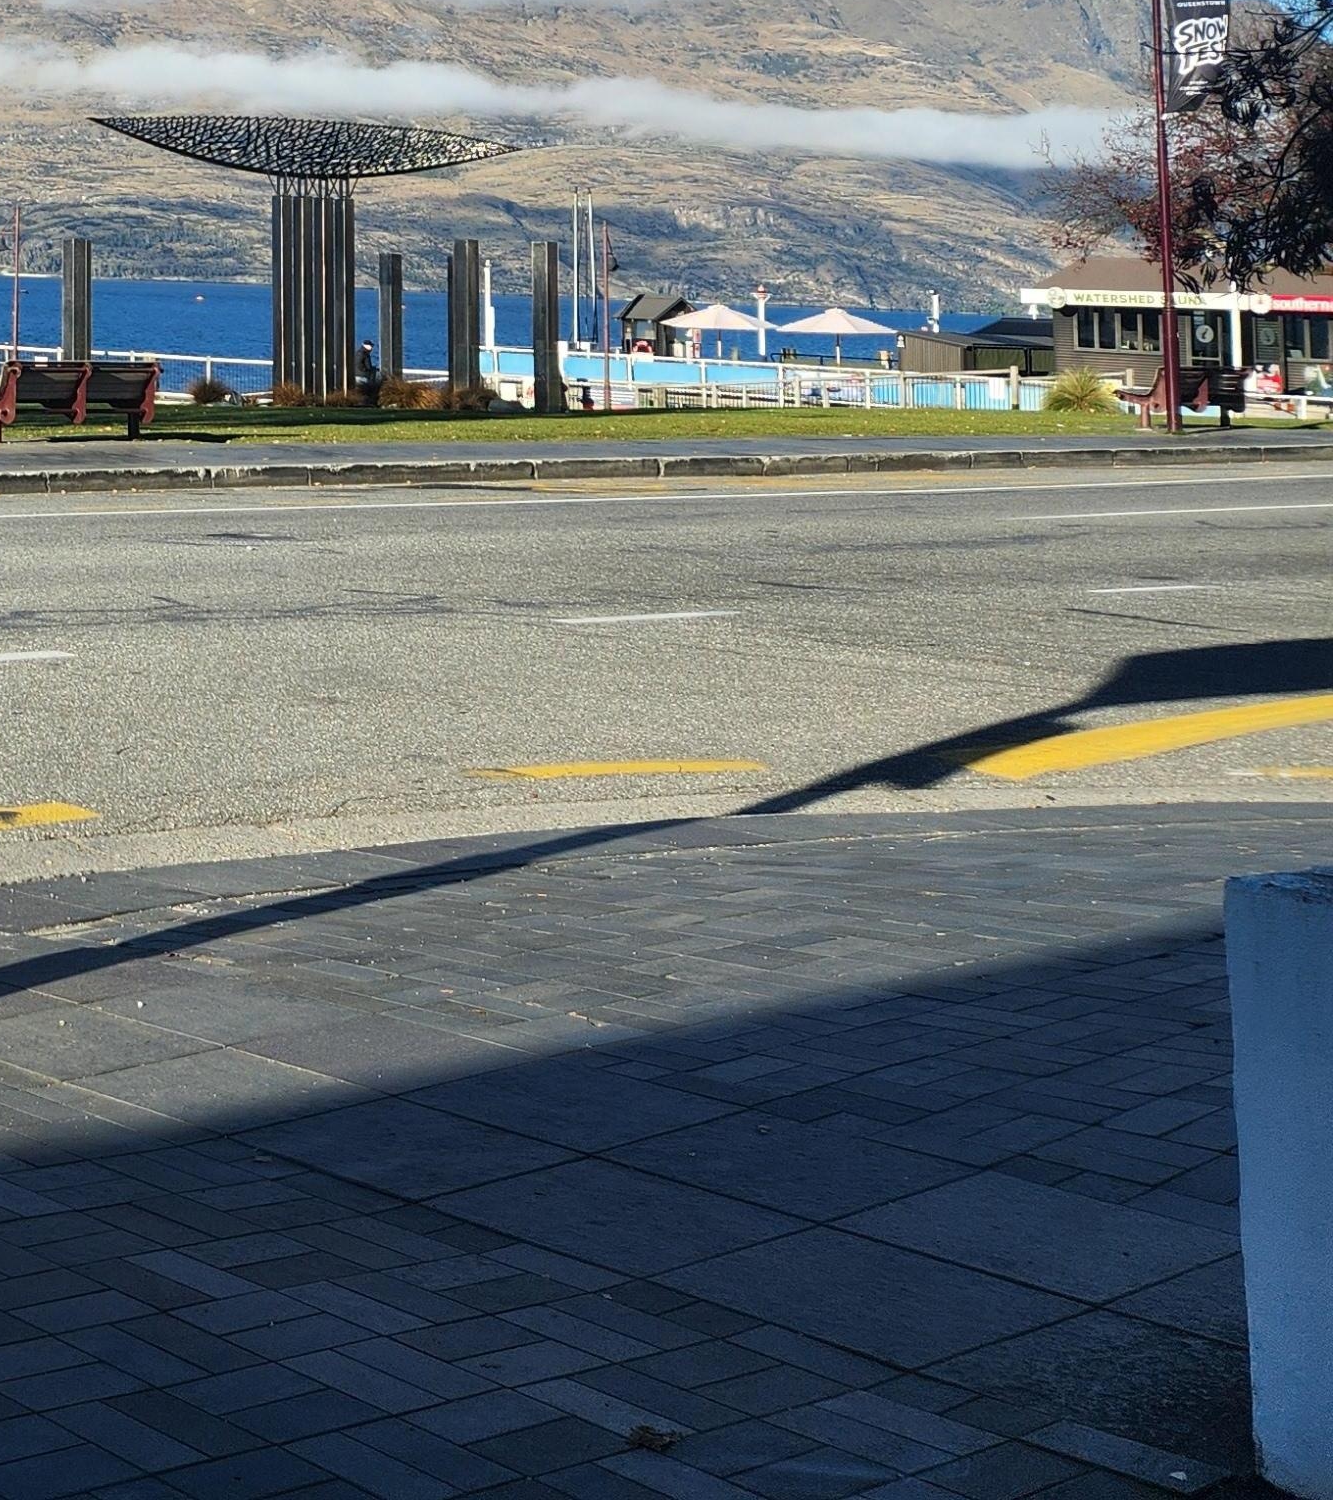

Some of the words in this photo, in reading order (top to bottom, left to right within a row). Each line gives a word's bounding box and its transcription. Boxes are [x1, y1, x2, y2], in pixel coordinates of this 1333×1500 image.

[1176, 0, 1226, 8] QUEENSTOWN
[1175, 15, 1228, 48] SNOW
[1073, 293, 1154, 304] WATERSHED
